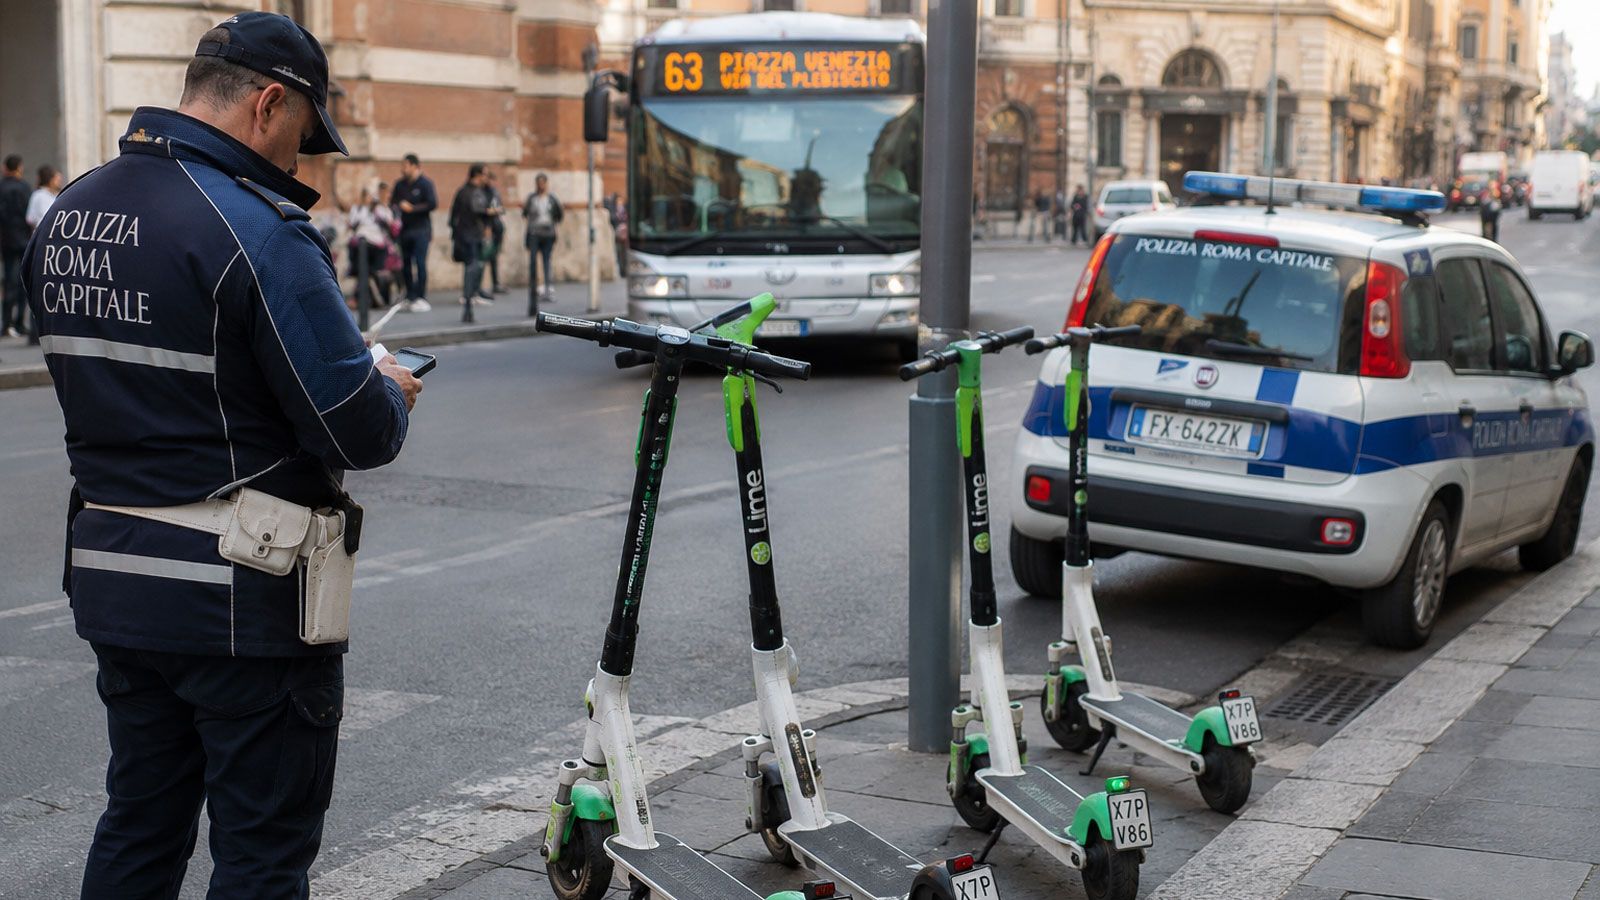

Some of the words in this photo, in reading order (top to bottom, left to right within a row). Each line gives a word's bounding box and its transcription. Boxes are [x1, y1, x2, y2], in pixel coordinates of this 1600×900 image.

[664, 52, 703, 91] 63
[719, 52, 796, 72] PIAZZA
[804, 50, 891, 72] VENEZIA
[720, 72, 751, 89] VIA
[48, 209, 139, 247] POLIZIA
[42, 245, 114, 281] ROMA
[1135, 237, 1197, 256] POLIZIA
[1201, 243, 1251, 261] ROMA
[1256, 248, 1333, 272] CAPITALE
[42, 281, 152, 325] CAPITALE
[746, 468, 767, 534] Lime
[972, 472, 989, 528] Lime
[1226, 702, 1252, 720] X7P
[1231, 721, 1258, 740] V86
[1112, 798, 1144, 820] X7P
[1116, 823, 1148, 844] V86
[956, 875, 990, 900] X7P
